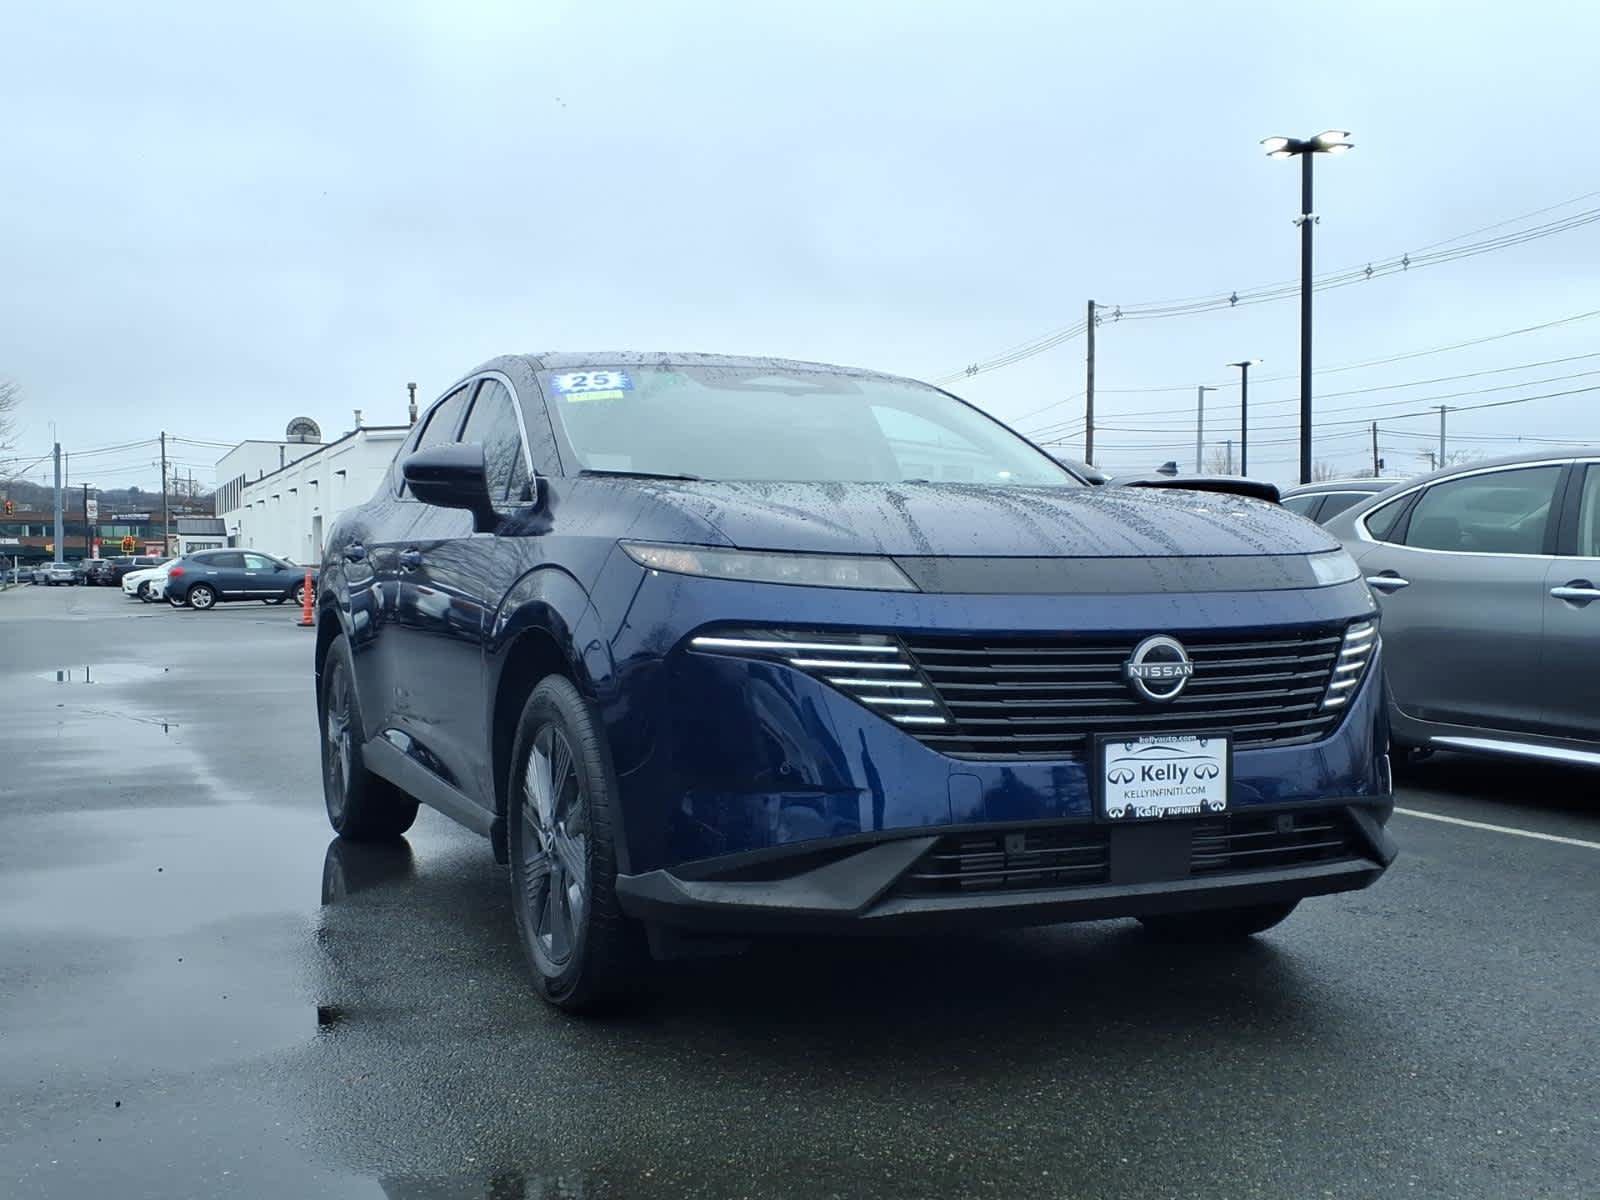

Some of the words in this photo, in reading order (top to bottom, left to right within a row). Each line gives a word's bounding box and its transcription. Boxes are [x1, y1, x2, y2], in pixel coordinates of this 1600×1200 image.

[571, 374, 609, 387] 25
[1130, 665, 1193, 677] NISSAN
[1139, 735, 1197, 745] kellyauto.com
[1141, 763, 1189, 784] Kelly
[1124, 786, 1206, 799] KELLYINFINITI.COM
[1136, 806, 1165, 818] Kelly
[1168, 806, 1201, 815] INFINITI
